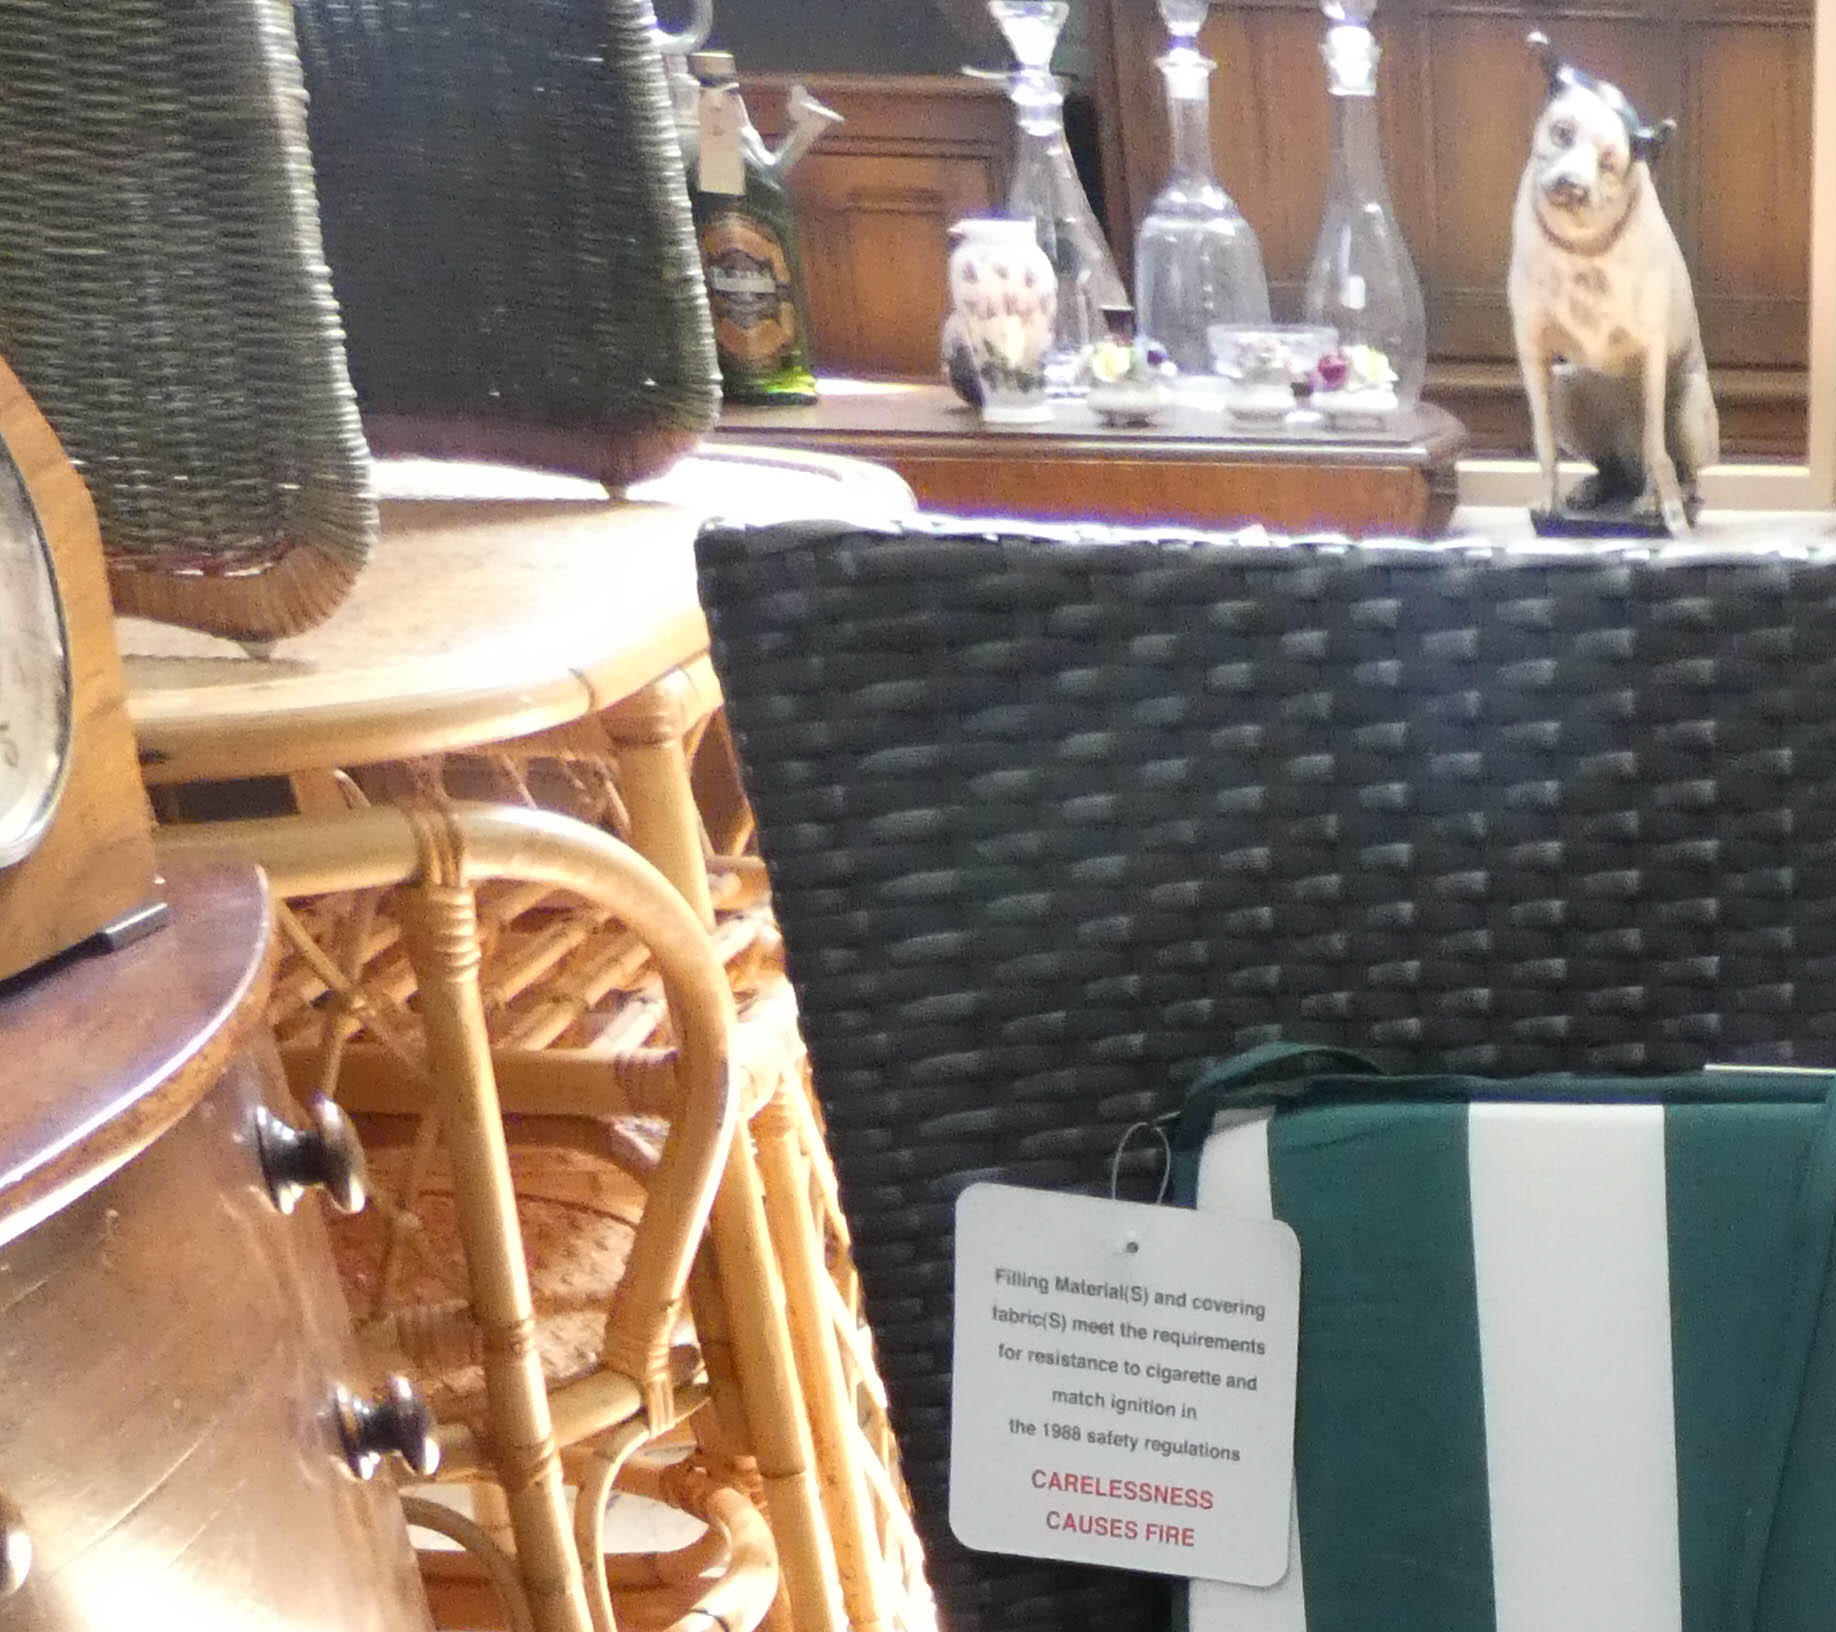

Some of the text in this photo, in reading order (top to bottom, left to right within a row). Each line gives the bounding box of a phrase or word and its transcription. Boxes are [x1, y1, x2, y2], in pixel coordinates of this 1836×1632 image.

[995, 1268, 1266, 1322] Filling Material(S) and covering
[992, 1305, 1266, 1356] fabric(S) meet the requirements
[998, 1343, 1258, 1391] for resistance to cigarette and
[1051, 1390, 1197, 1420] match ignition in
[1008, 1418, 1241, 1462] the 1988 safety regulations
[1031, 1468, 1214, 1511] CARELESSNESS
[1045, 1510, 1195, 1548] CAUSES FIRE
